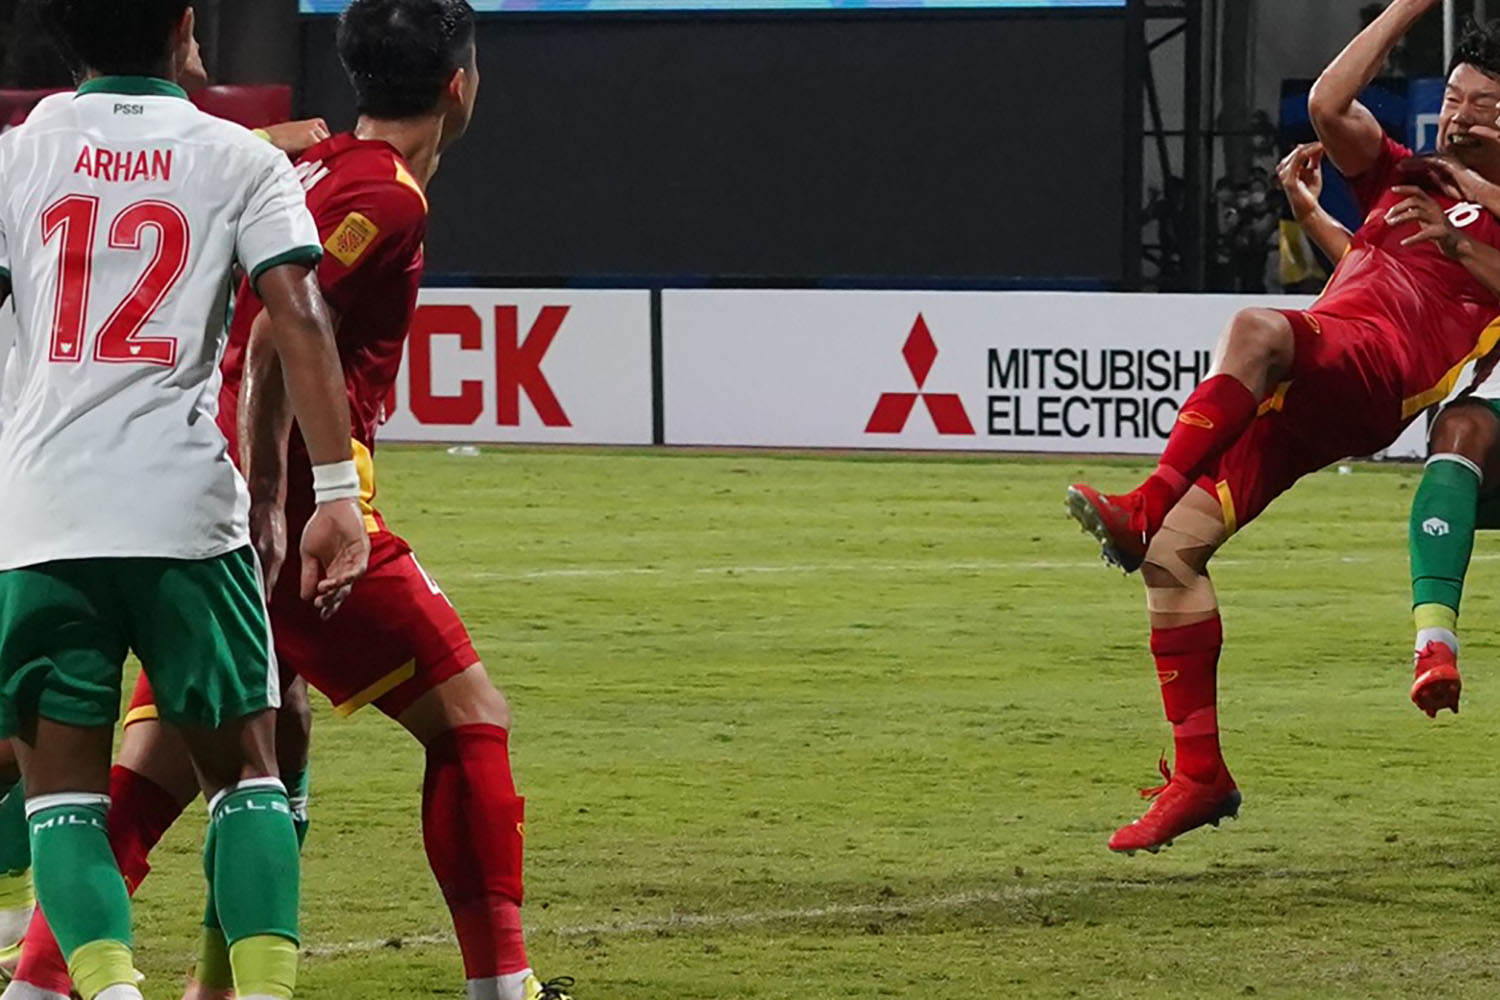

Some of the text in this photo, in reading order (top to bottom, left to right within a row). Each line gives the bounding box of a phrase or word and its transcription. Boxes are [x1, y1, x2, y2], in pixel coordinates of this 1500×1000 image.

[113, 103, 144, 115] PSSI
[73, 145, 172, 182] ARHAN
[41, 193, 191, 368] 12
[381, 304, 573, 427] CK
[987, 348, 1210, 391] MITSUBISHI
[987, 396, 1179, 439] ELECTRIC
